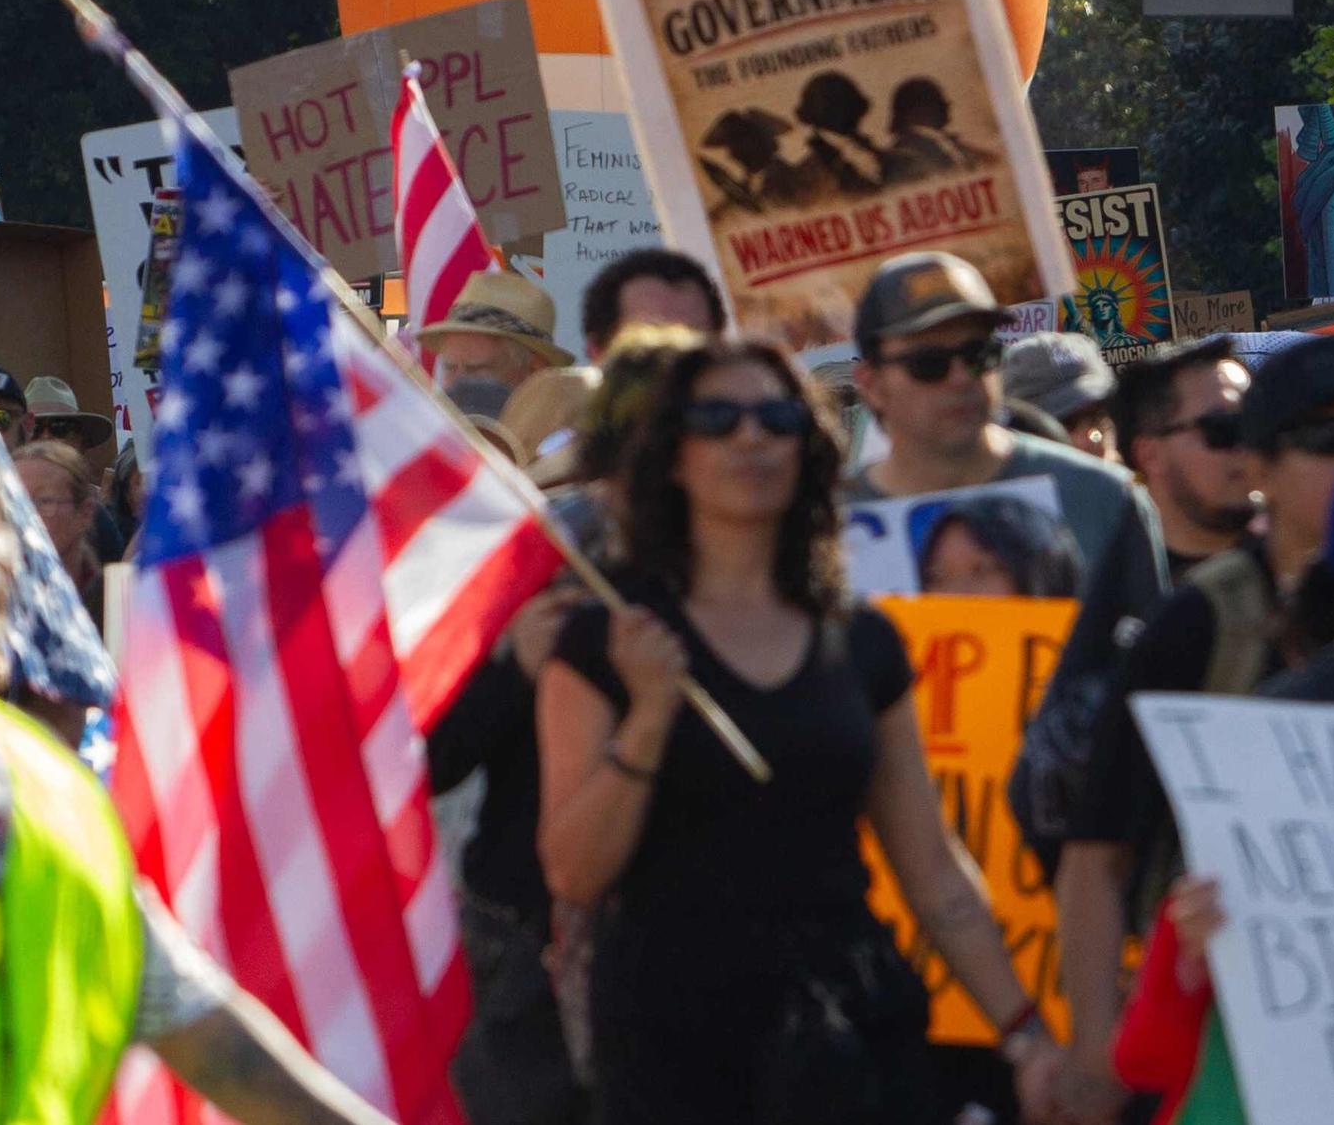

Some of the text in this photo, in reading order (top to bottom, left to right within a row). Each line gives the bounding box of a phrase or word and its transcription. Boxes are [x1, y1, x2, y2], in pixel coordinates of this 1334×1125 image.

[260, 80, 359, 163] HOT
[564, 121, 643, 170] FEMINIS
[564, 181, 637, 207] RADICAL
[728, 177, 999, 274] WARNED US ABOUT
[1174, 297, 1248, 326] No More
[1153, 707, 1236, 803] I
